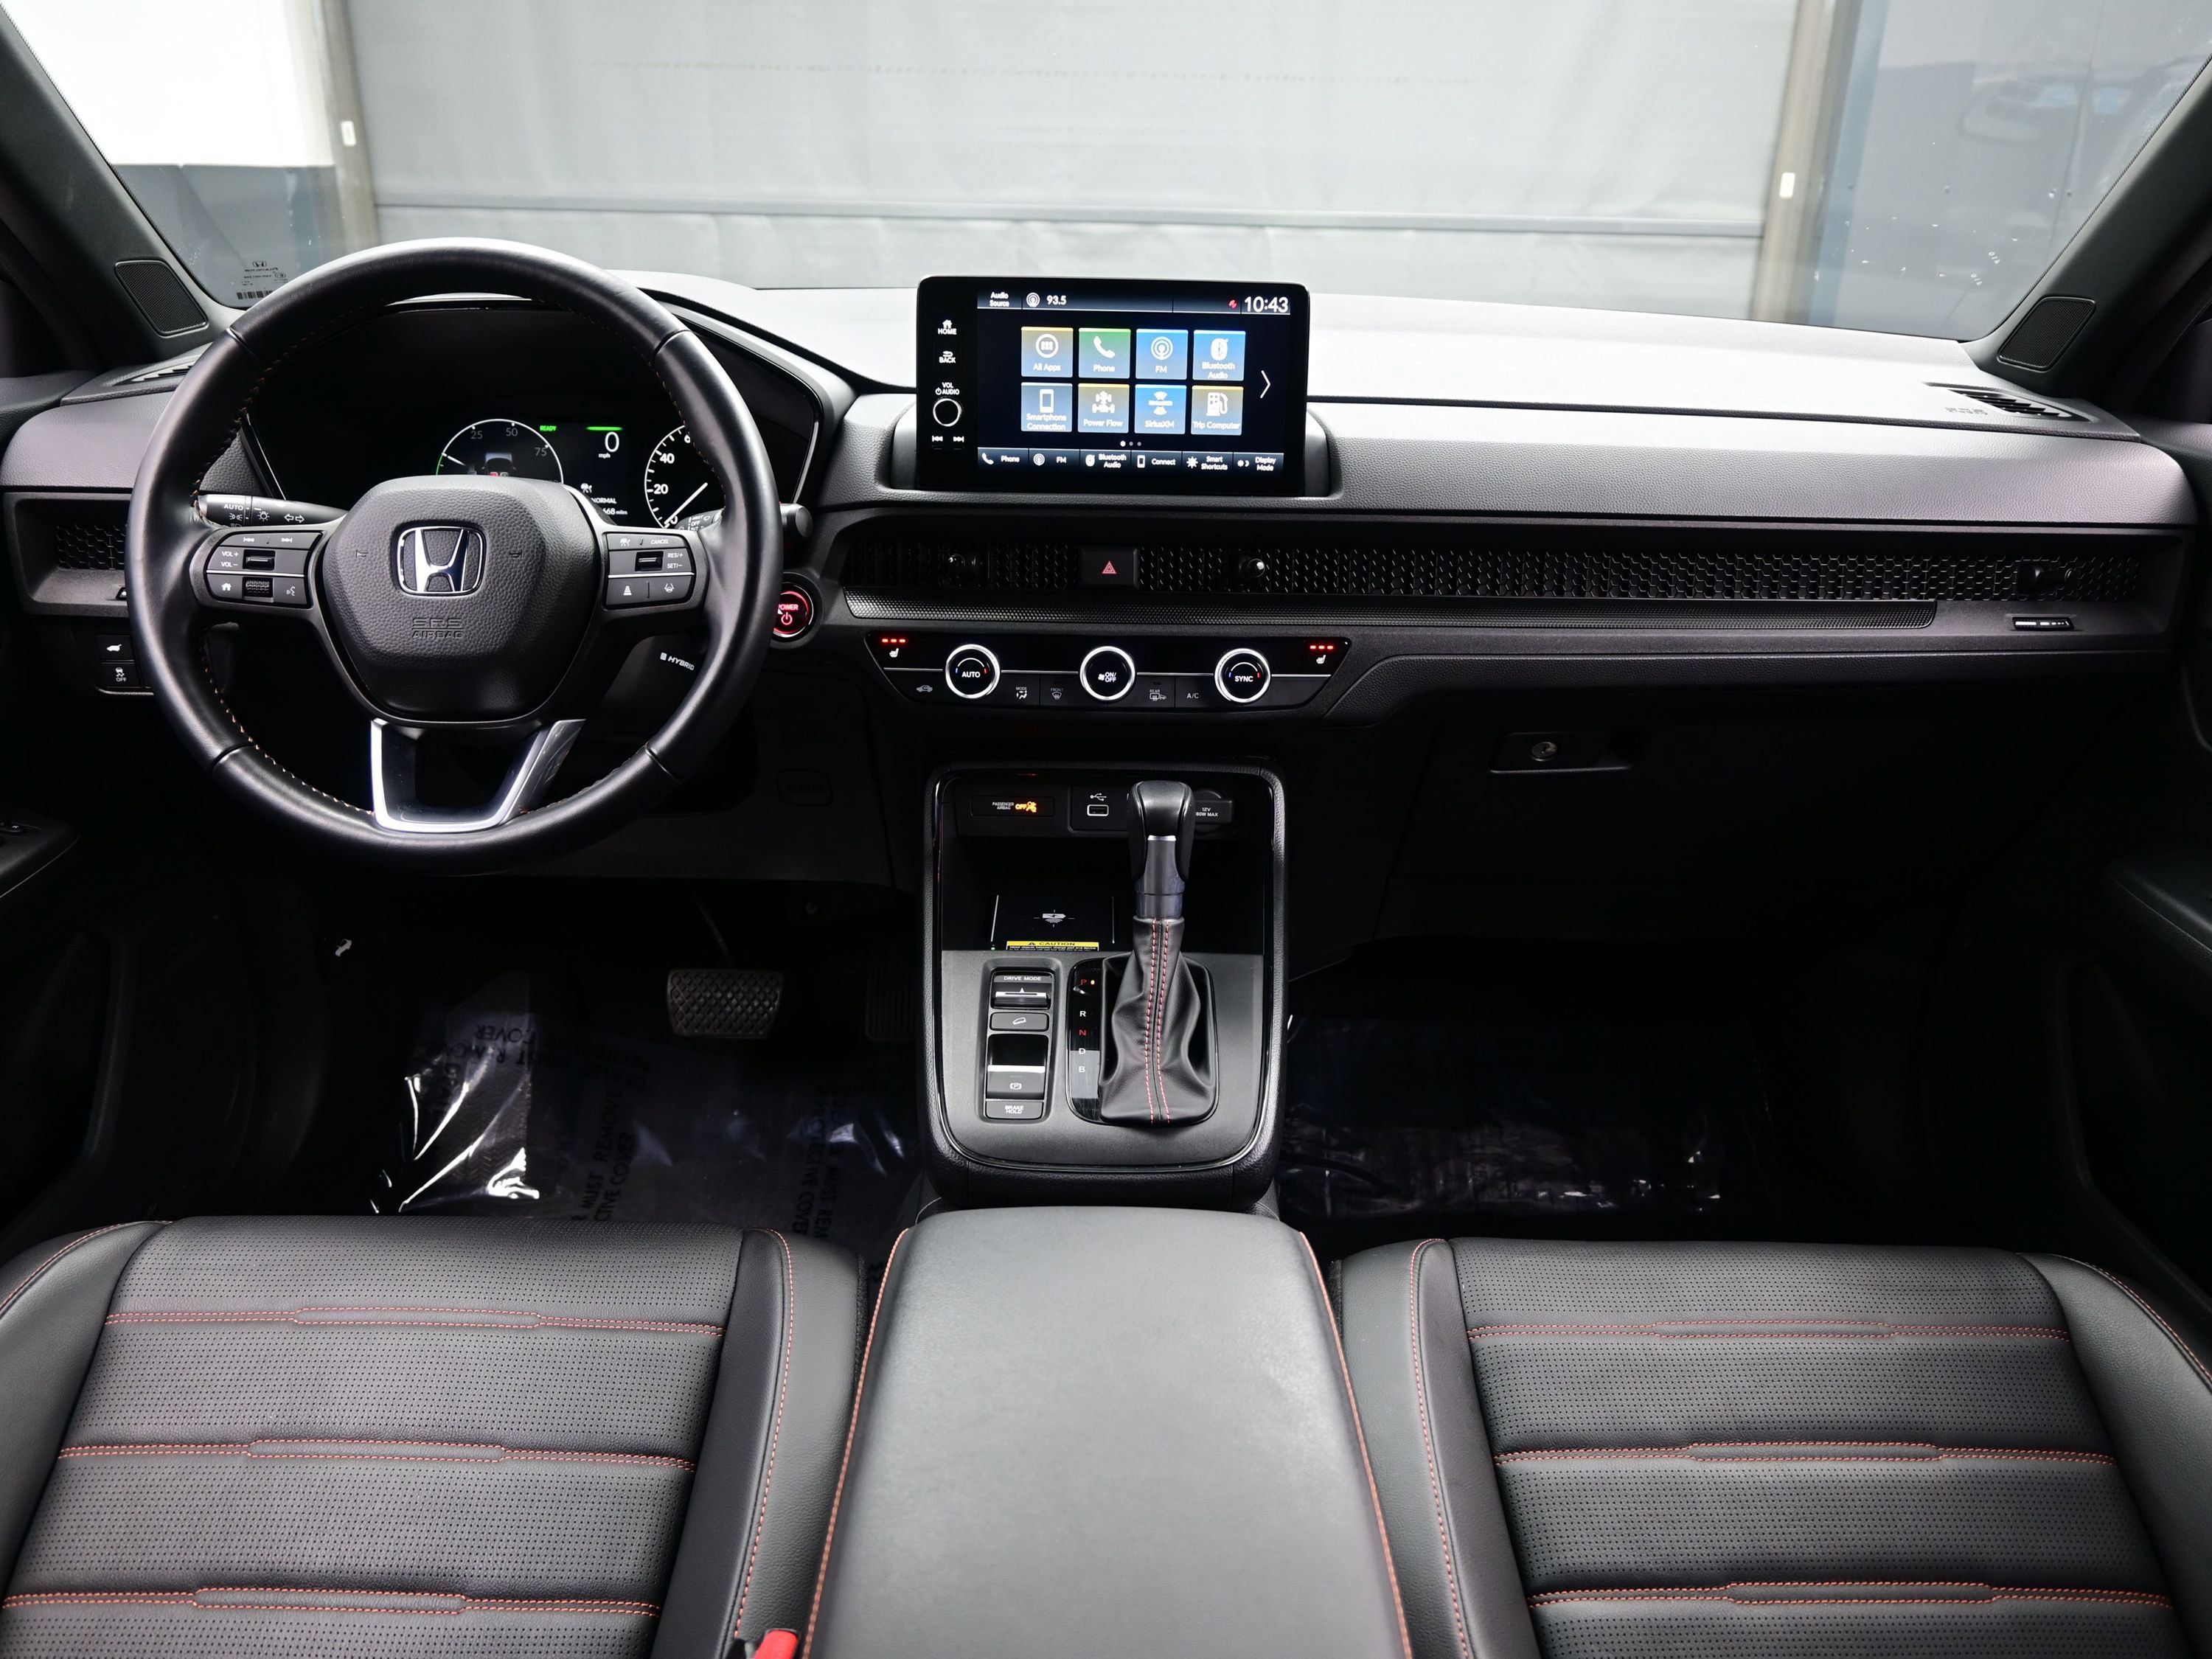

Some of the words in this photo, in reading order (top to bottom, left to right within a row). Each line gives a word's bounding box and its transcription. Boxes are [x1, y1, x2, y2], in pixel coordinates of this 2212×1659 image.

[1046, 295, 1067, 305] 93.5
[1244, 296, 1289, 313] 10:43
[1033, 363, 1042, 371] All
[1043, 364, 1061, 372] Apps
[1093, 364, 1115, 372] Phone
[1202, 362, 1235, 370] Bluetooth
[1026, 414, 1067, 422] Smartphone
[1083, 419, 1105, 427] Power
[1144, 420, 1175, 428] SiriusXM
[1193, 421, 1206, 429] Trip
[1206, 421, 1240, 430] Computer
[470, 431, 483, 439] 25
[506, 428, 518, 437] 50
[604, 431, 620, 453] 0
[535, 448, 547, 456] 75
[659, 453, 675, 464] 40
[1001, 455, 1020, 463] Phone
[1151, 458, 1176, 466] Connect
[1255, 456, 1276, 465] Display
[653, 484, 669, 494] 20
[667, 655, 695, 671] HYBRID
